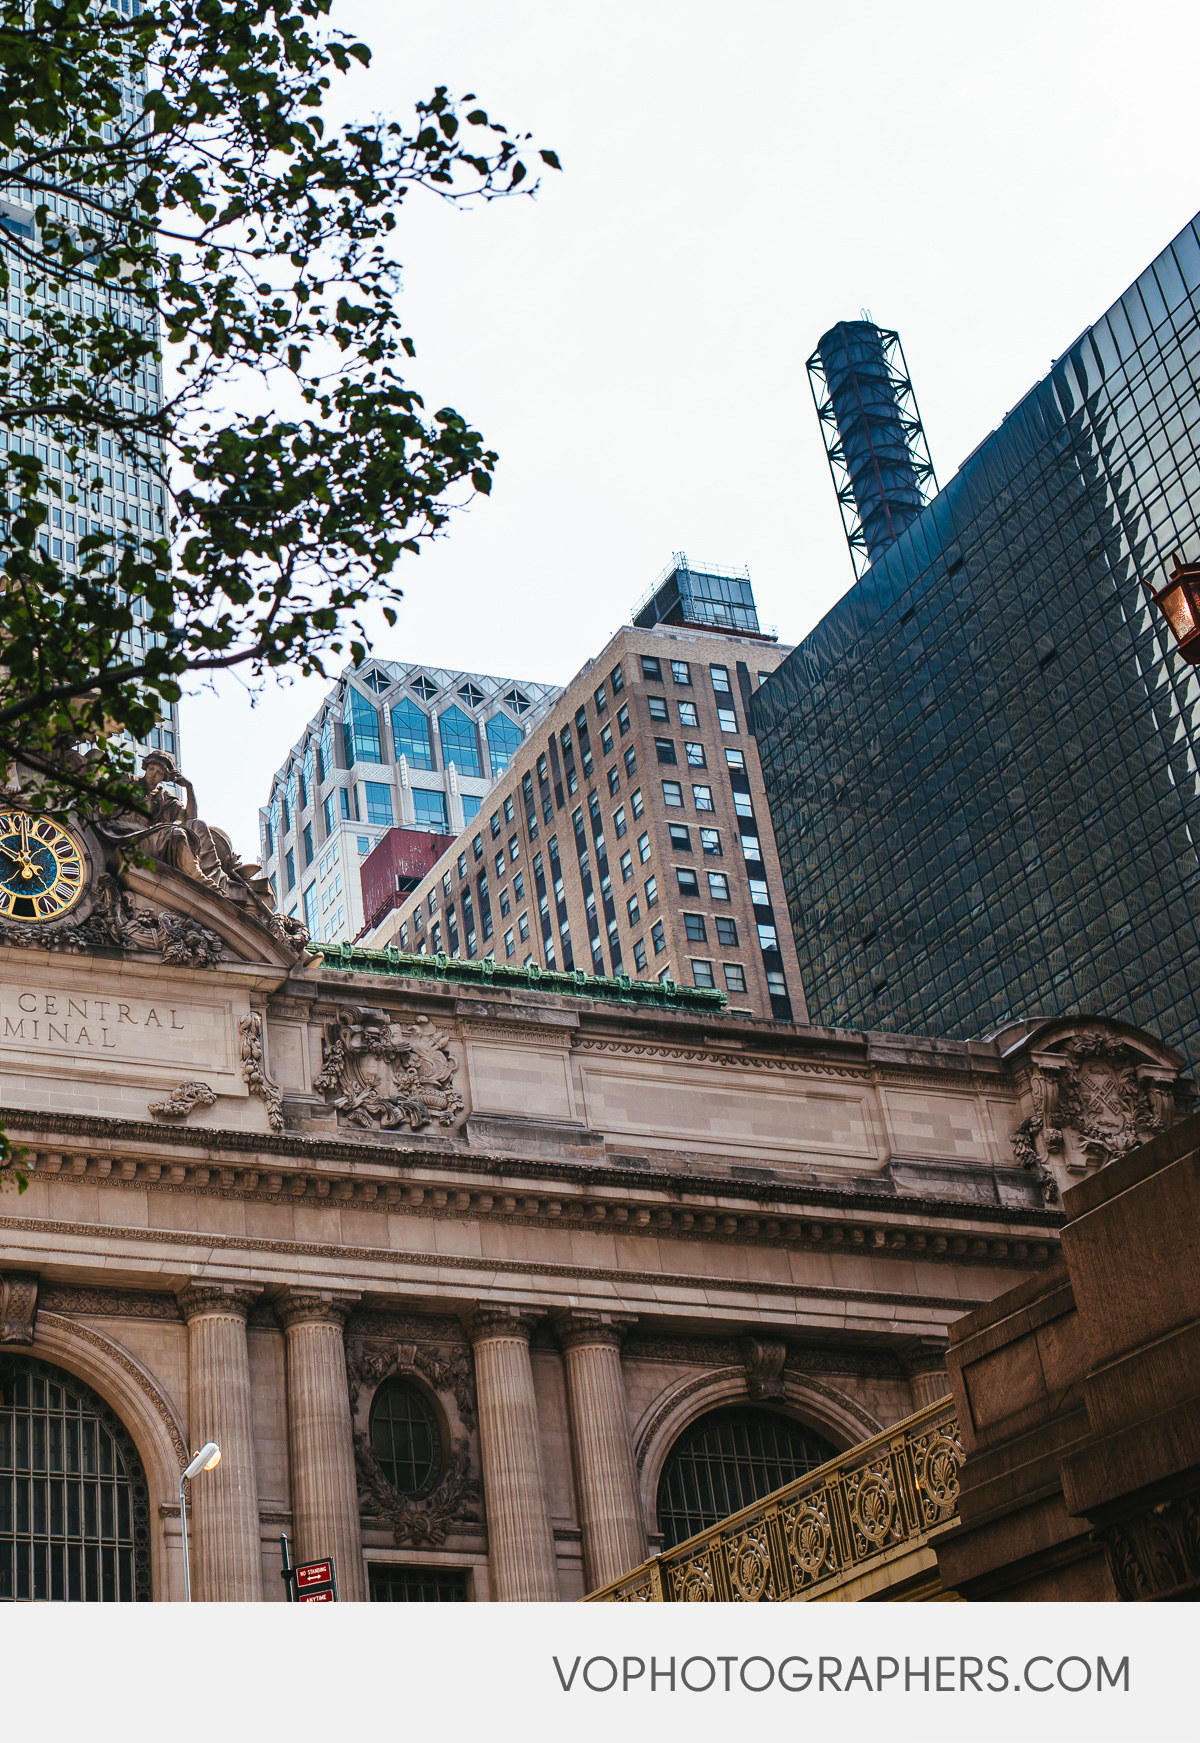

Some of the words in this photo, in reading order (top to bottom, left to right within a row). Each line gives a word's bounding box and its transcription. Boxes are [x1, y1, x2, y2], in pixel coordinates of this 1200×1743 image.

[18, 992, 185, 1030] CENTRAL
[307, 1566, 326, 1575] STANDING
[306, 1594, 326, 1602] ANYTIME
